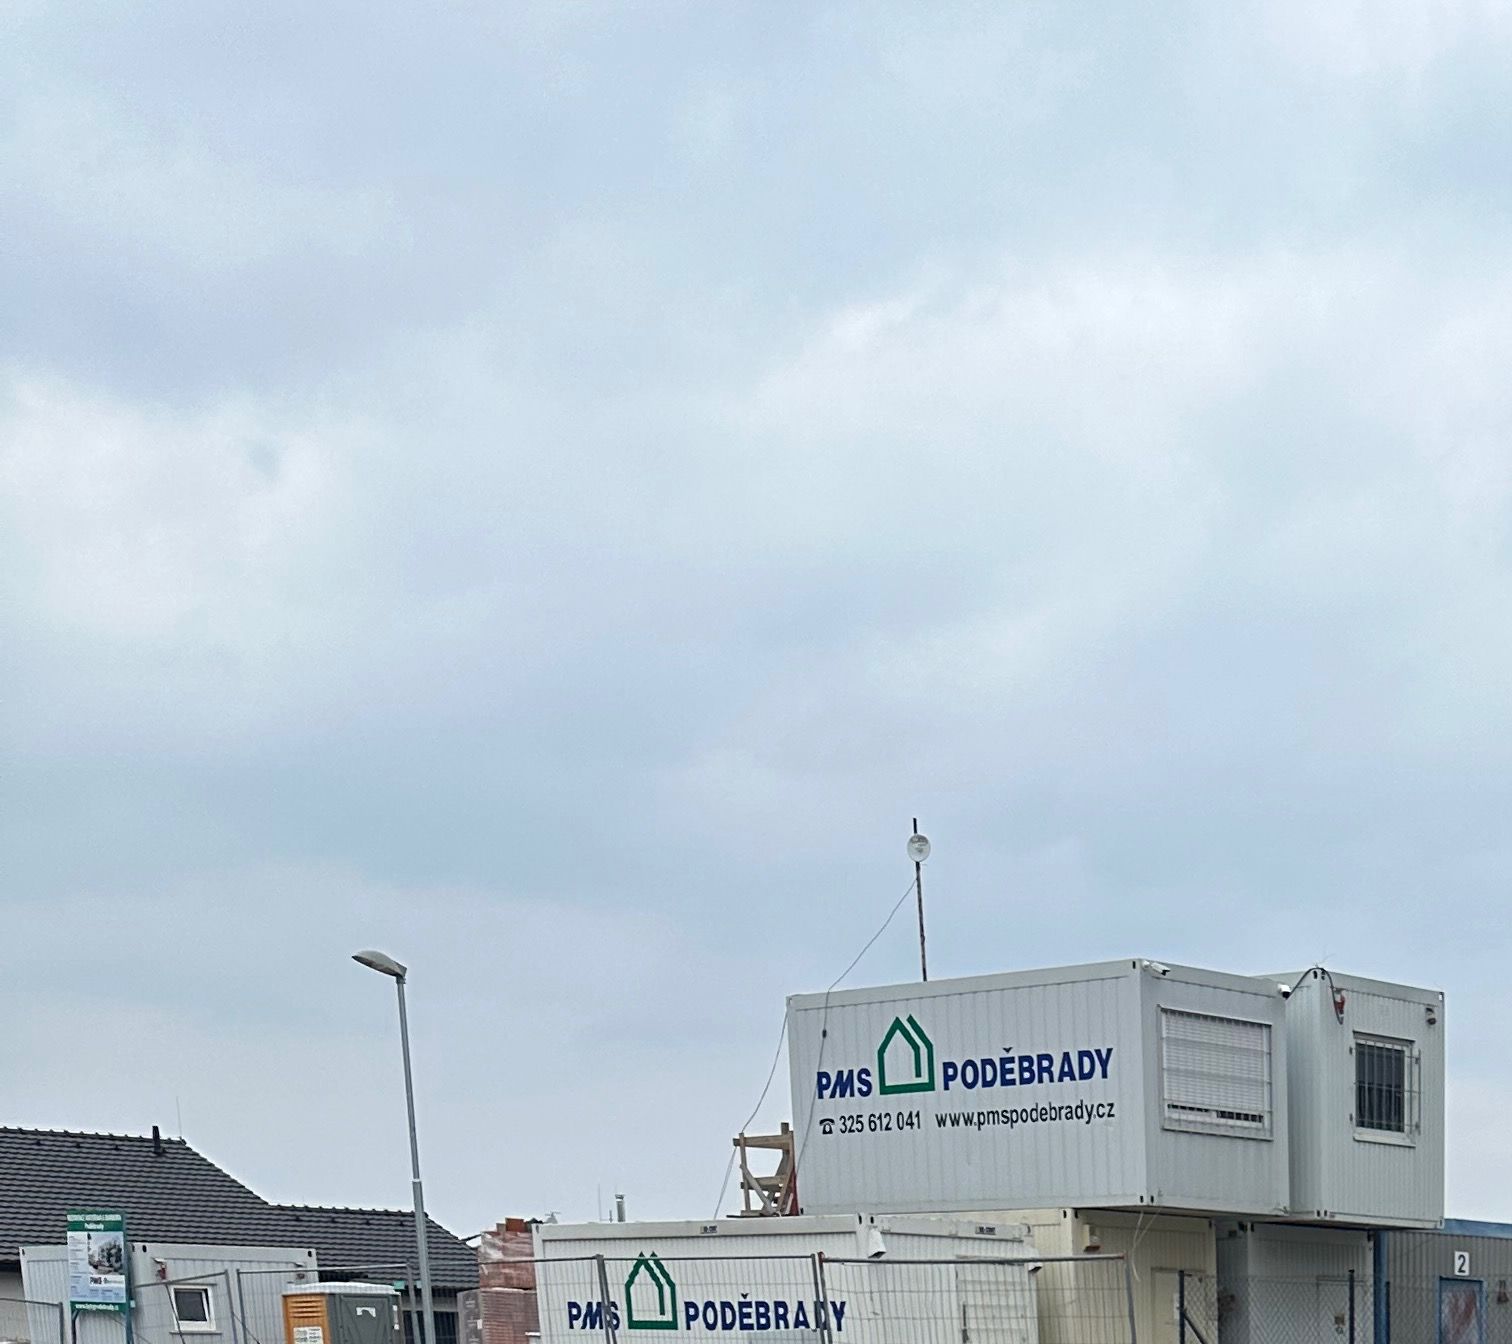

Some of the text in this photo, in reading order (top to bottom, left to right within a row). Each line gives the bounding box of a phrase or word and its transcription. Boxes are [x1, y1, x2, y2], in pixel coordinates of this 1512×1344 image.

[816, 1047, 1113, 1100] PMS PODĚBRADY
[839, 1099, 1115, 1134] 325 612 041 www.pmspodebrady.cz
[1457, 1254, 1466, 1273] 2
[567, 1301, 620, 1330] PMS
